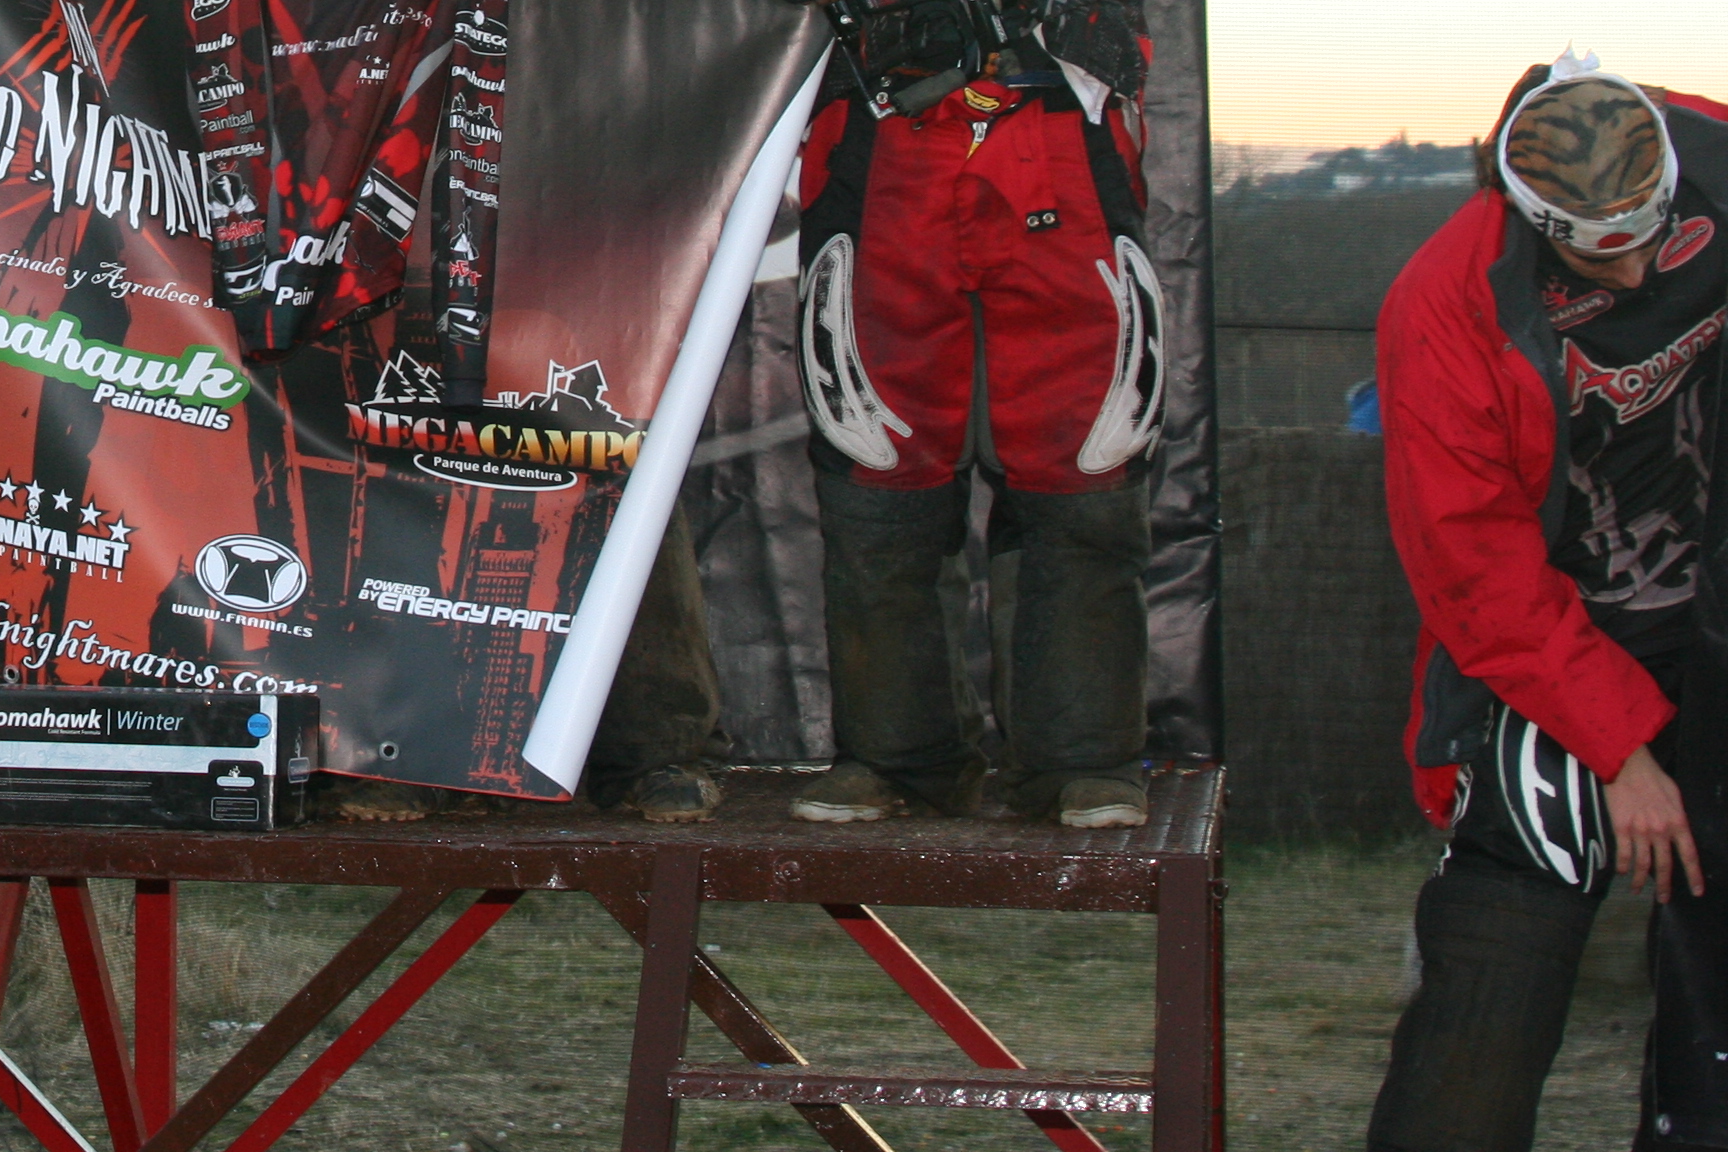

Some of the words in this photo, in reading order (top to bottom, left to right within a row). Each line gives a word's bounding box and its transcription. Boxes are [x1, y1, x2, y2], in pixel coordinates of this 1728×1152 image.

[93, 382, 232, 431] Paintballs
[433, 455, 481, 474] Parque
[482, 460, 501, 475] de
[502, 463, 564, 483] Aventura
[364, 578, 431, 597] POWERED
[358, 589, 378, 602] BY
[377, 591, 490, 625] ENERGY
[117, 711, 184, 733] Winter
